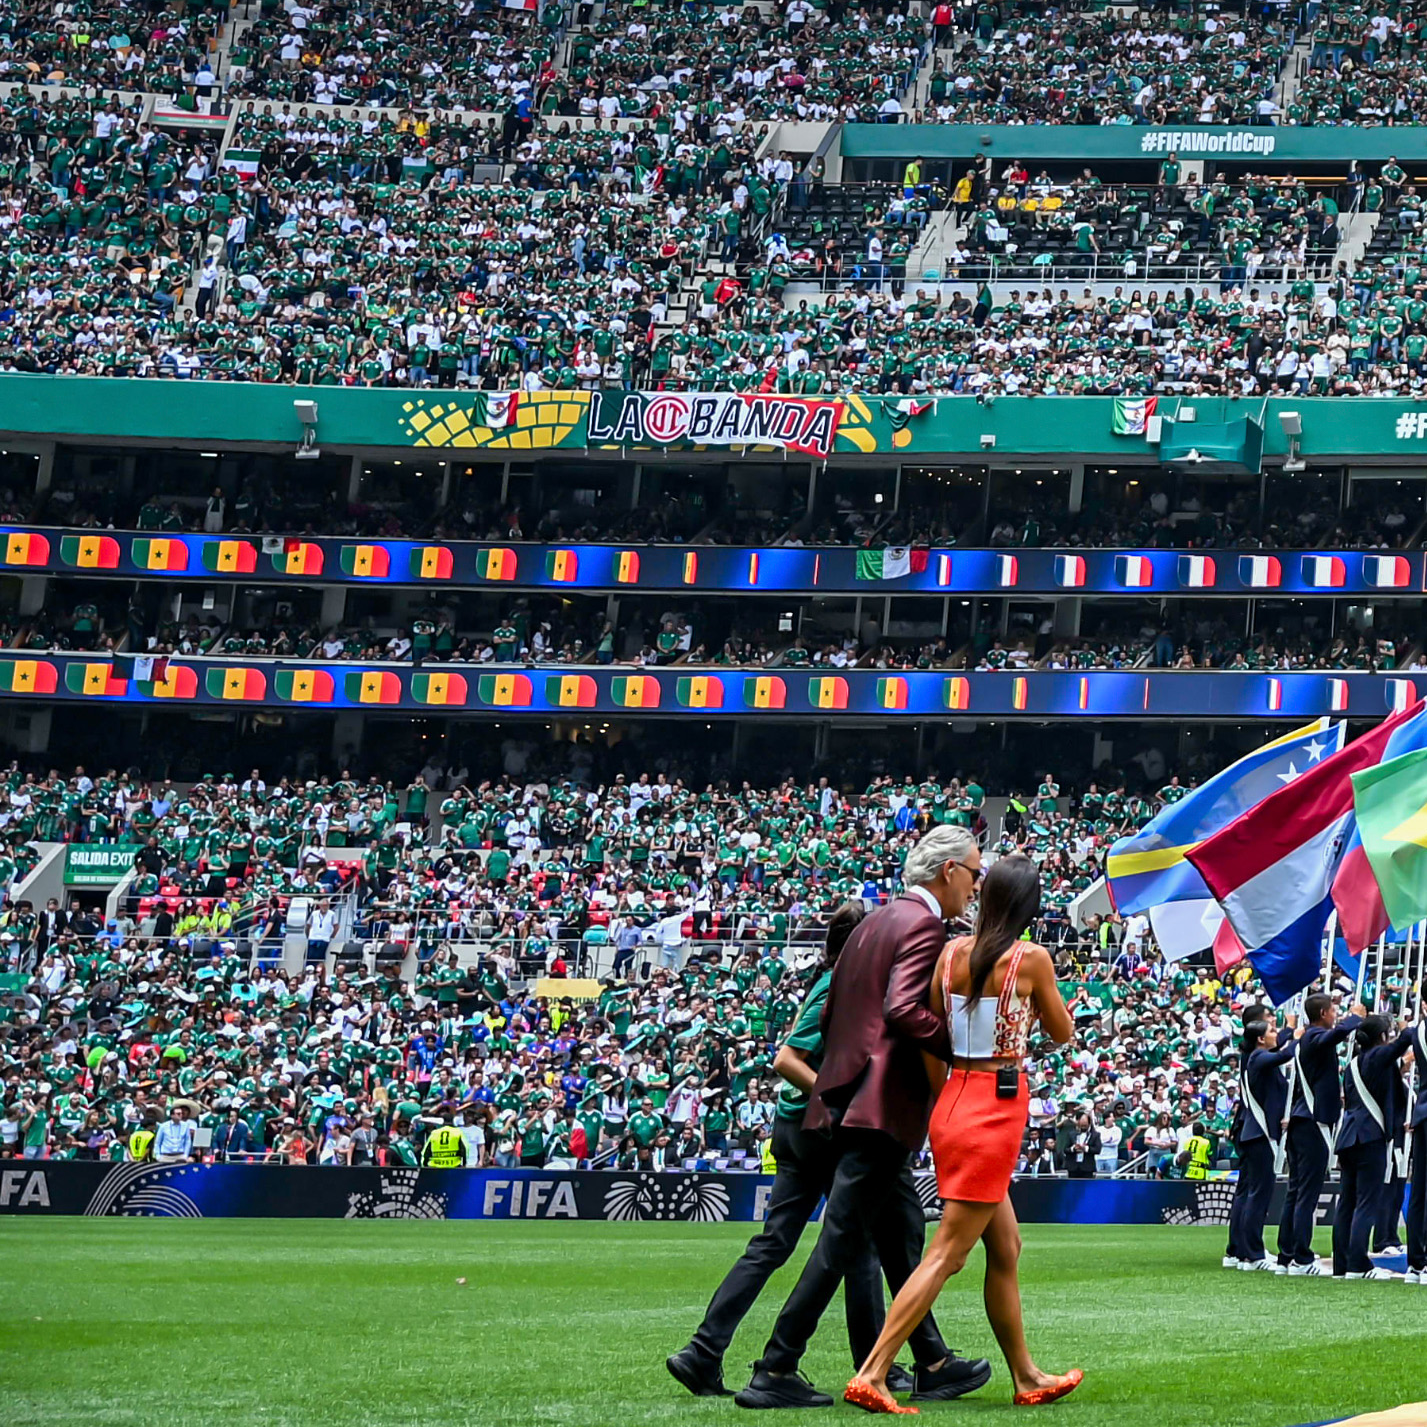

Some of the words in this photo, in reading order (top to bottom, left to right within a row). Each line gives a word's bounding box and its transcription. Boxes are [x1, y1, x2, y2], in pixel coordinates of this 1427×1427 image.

[1140, 132, 1275, 156] #FIFAWorldCup
[588, 392, 645, 441] LA
[687, 395, 835, 455] BANDA
[70, 851, 109, 866] SALIDA
[110, 852, 135, 867] EXIT
[482, 1180, 579, 1218] FIFA
